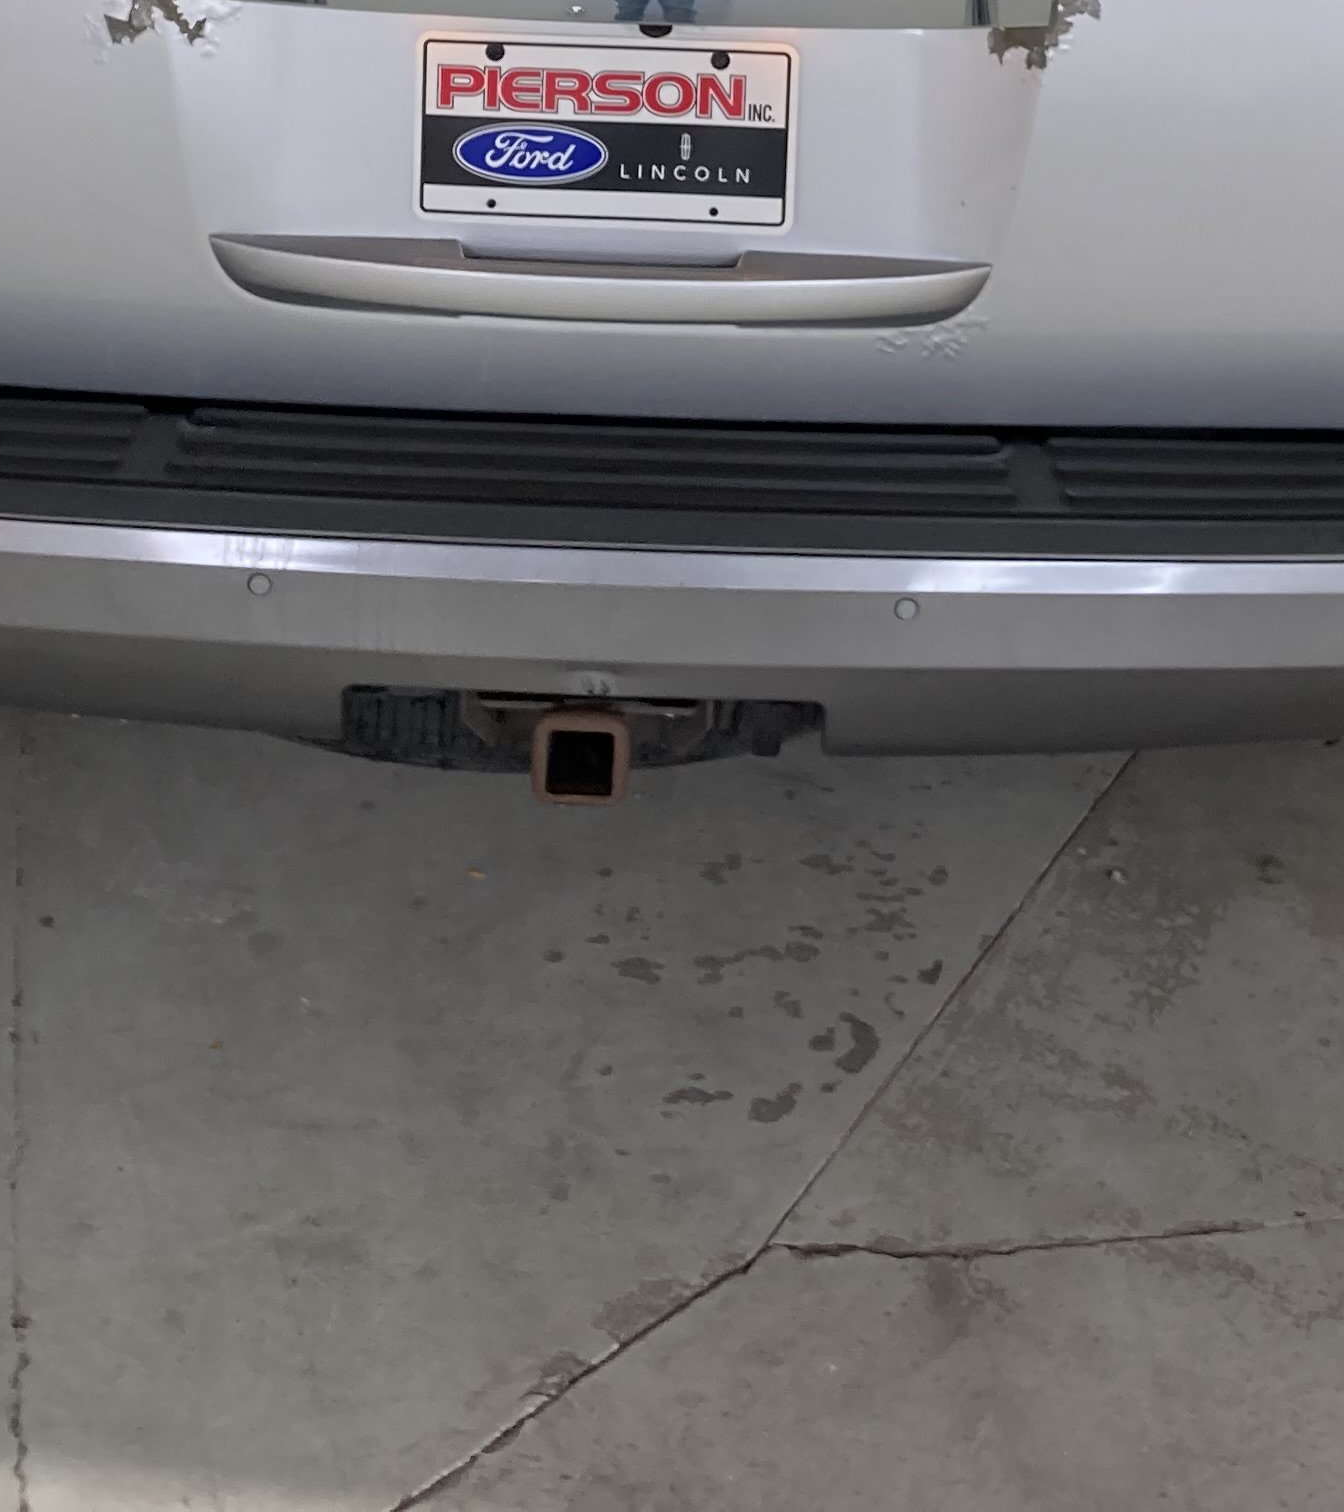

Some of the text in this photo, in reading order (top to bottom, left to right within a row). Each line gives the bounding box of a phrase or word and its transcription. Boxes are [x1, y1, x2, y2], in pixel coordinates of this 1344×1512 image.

[436, 64, 776, 123] PIERSON INC.
[484, 131, 576, 171] Ford
[619, 163, 752, 184] LINCOLN
